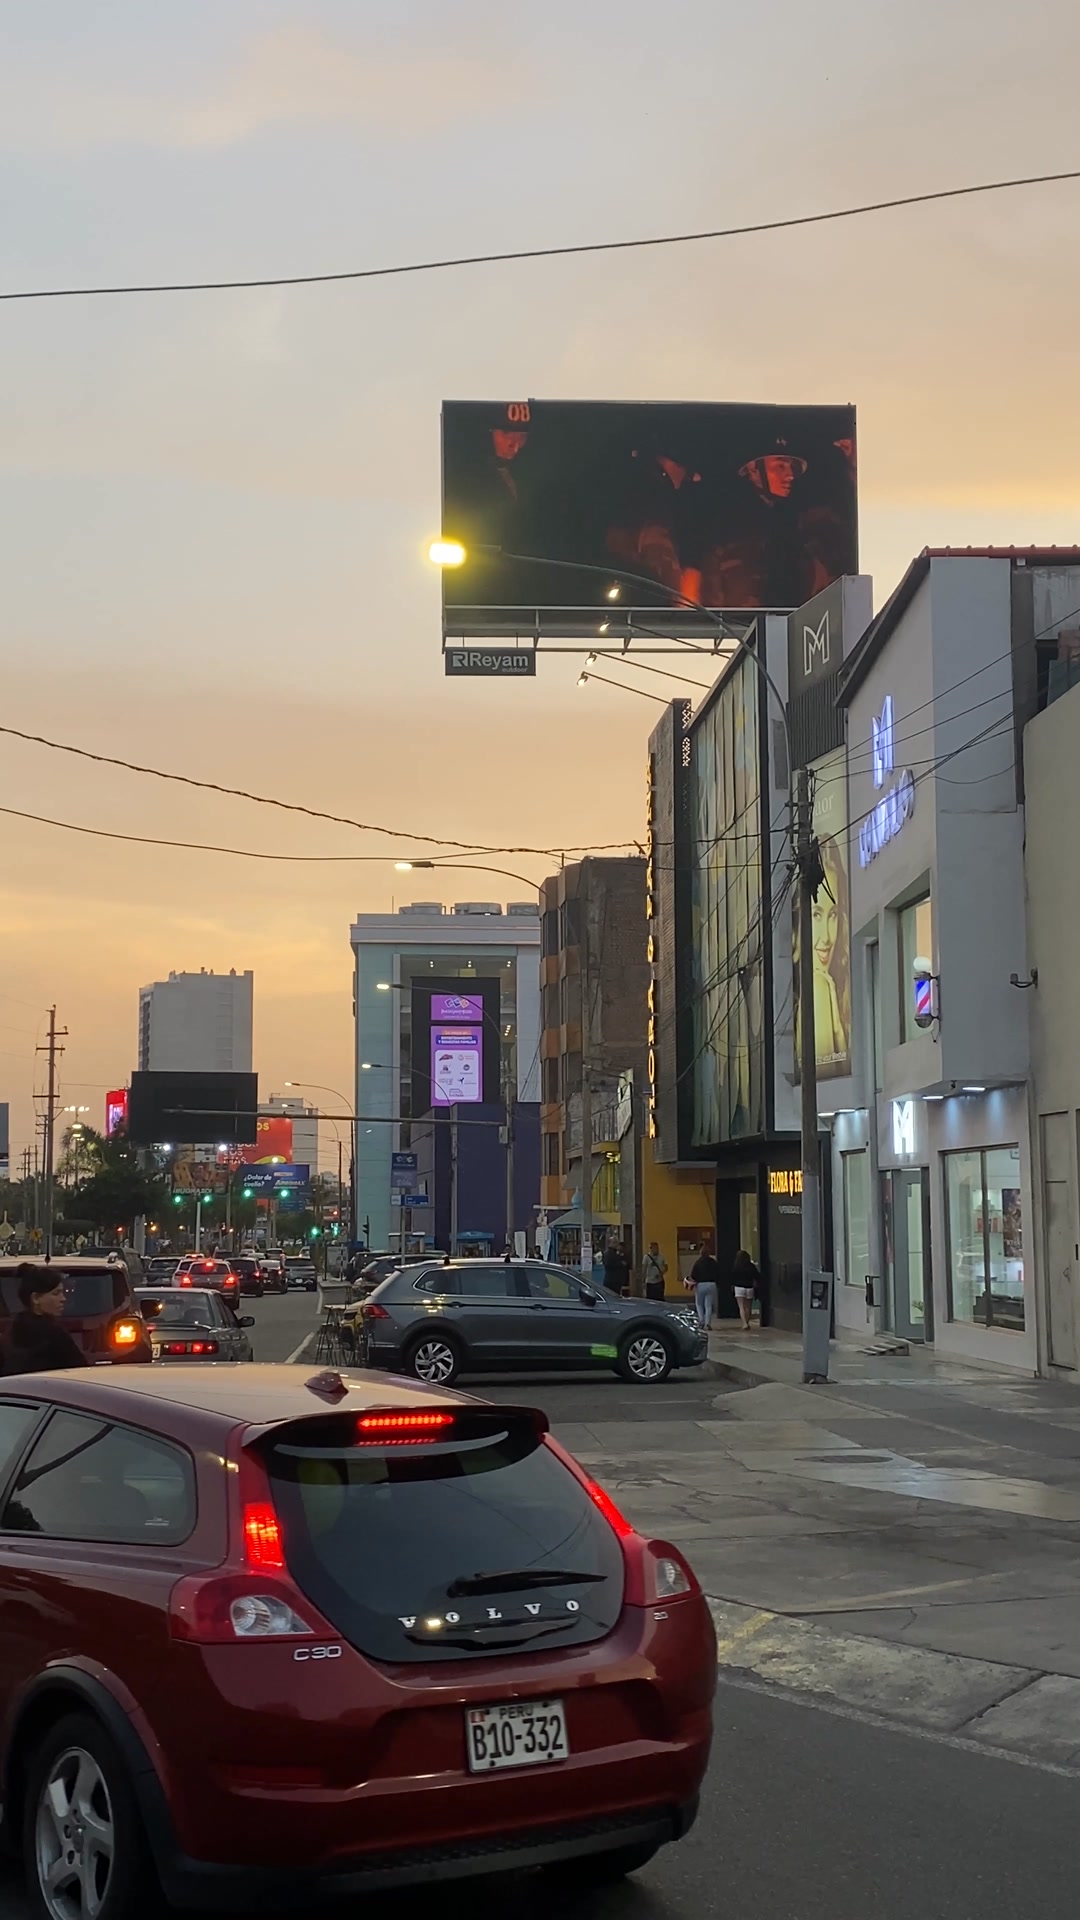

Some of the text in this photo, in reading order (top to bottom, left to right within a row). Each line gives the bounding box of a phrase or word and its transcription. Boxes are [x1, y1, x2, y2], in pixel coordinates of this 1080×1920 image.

[469, 653, 528, 670] Reyam
[398, 1600, 580, 1629] VOLVO
[293, 1645, 342, 1661] C30
[499, 1704, 534, 1719] PERU
[472, 1714, 563, 1761] B10-332
